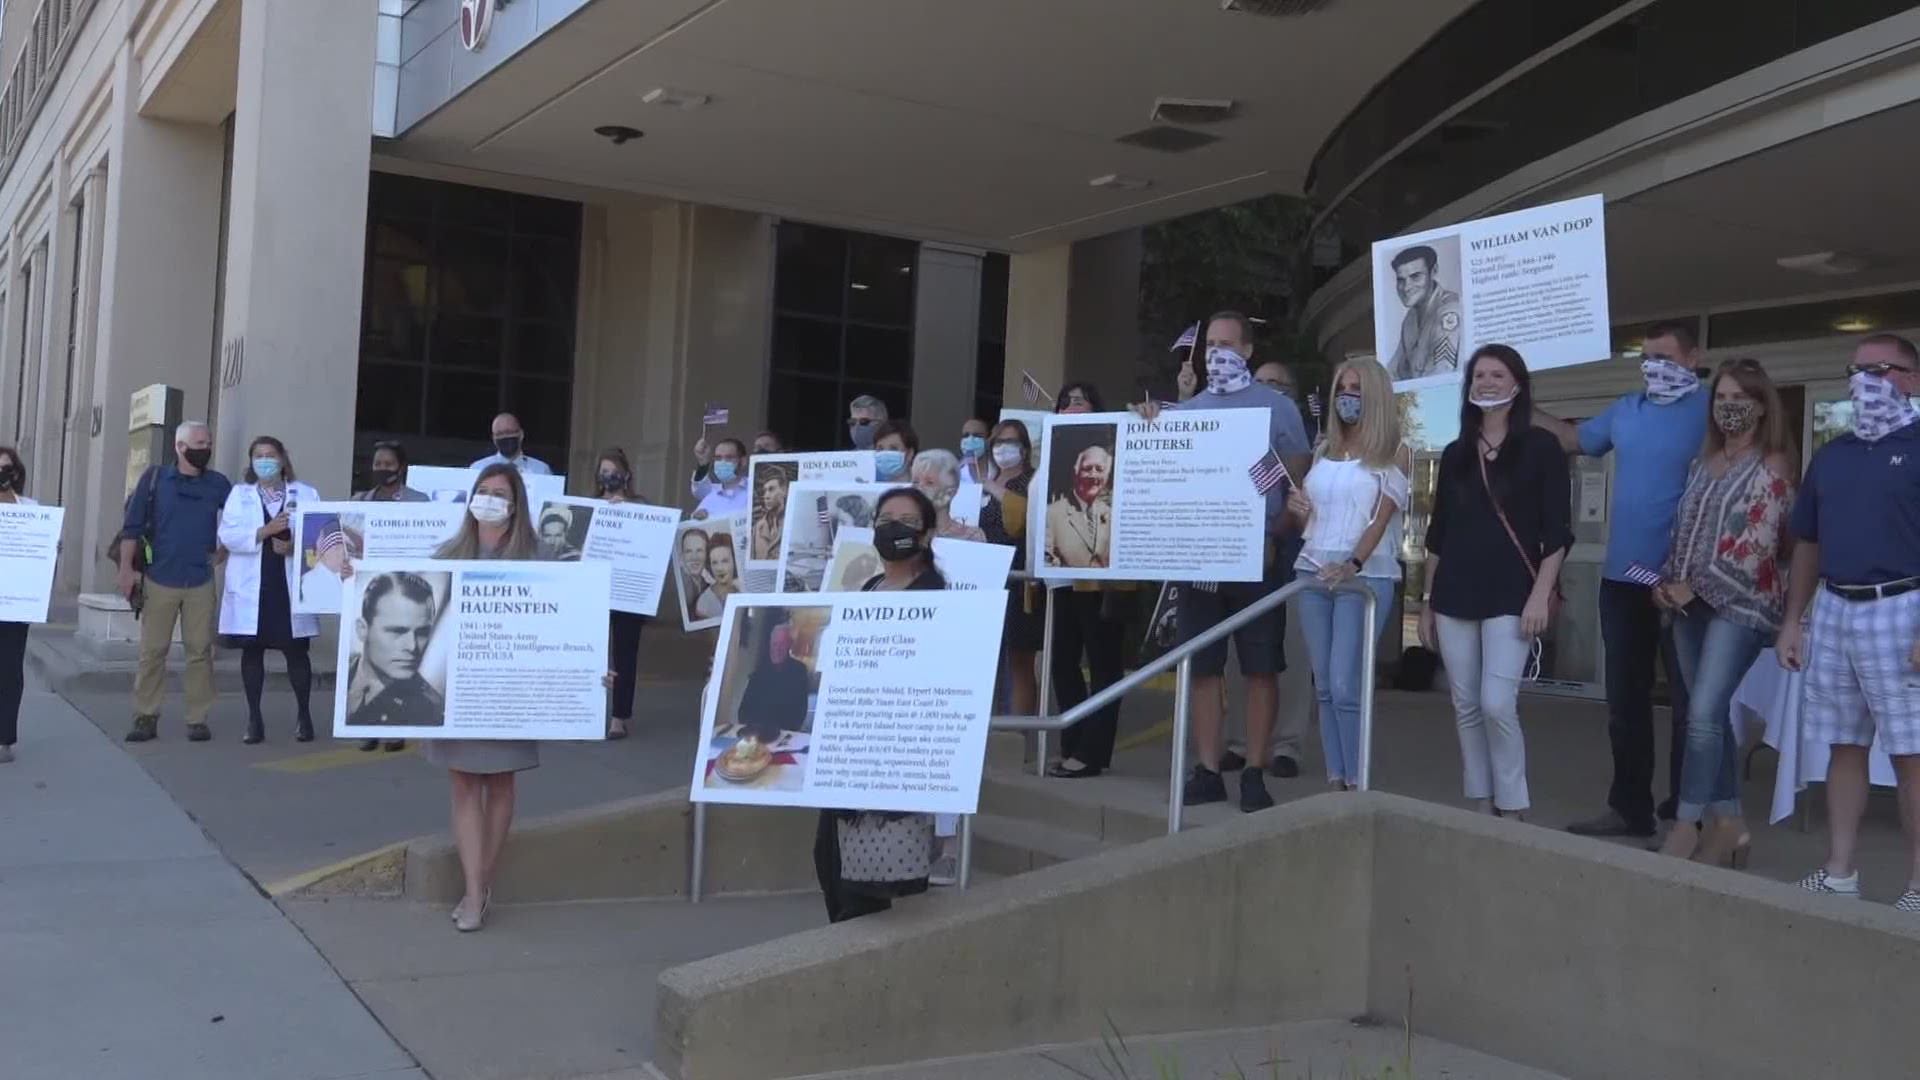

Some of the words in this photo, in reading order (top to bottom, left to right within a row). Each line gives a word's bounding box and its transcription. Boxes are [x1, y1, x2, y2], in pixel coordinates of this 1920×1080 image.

[1471, 231, 1528, 251] WILLIAM
[1532, 225, 1559, 239] VAN
[1563, 217, 1593, 233] DOP
[1471, 264, 1495, 275] Served
[1497, 261, 1515, 270] from
[1472, 273, 1499, 285] Highest
[1522, 264, 1553, 275] Sergeant
[1127, 423, 1160, 435] JOHN
[1164, 421, 1220, 432] GERARD
[1126, 439, 1193, 450] BOUTERSE
[803, 462, 823, 470] GENE
[832, 461, 858, 469] OLSON
[0, 511, 38, 520] ACKSON,
[598, 508, 632, 519] GEORGE
[634, 512, 672, 523] FRANCES
[370, 519, 410, 528] GEORGE
[413, 519, 448, 528] DEVON
[462, 585, 512, 597] RALPH
[517, 585, 532, 598] W.
[460, 602, 558, 614] HAUENSTEIN
[842, 607, 894, 621] DAVID
[898, 607, 938, 621] LOW
[459, 632, 486, 640] United
[515, 633, 538, 642] Army
[837, 635, 868, 644] Private
[869, 635, 889, 644] First
[892, 635, 916, 644] Class
[457, 642, 492, 651] Colonel,
[513, 643, 560, 653] Intelligence
[563, 643, 594, 652] Branch,
[457, 652, 473, 661] HQ
[836, 647, 850, 656] U.S.
[855, 647, 886, 657] Marine
[889, 647, 916, 659] Corps
[834, 659, 878, 669] 1945-1946
[829, 686, 847, 695] Good
[849, 686, 879, 695] Conduct
[907, 687, 931, 697] Expert
[827, 697, 856, 706] National
[876, 698, 895, 706] Team
[896, 698, 911, 706] East
[913, 698, 933, 707] Coast
[865, 711, 893, 720] pouring
[874, 722, 895, 730] Island
[915, 724, 934, 732] camp
[839, 733, 864, 742] ground
[898, 734, 917, 743] Japan
[907, 747, 929, 755] orders
[817, 755, 832, 764] hold
[834, 755, 848, 764] that
[816, 768, 834, 776] know
[836, 769, 850, 778] why
[848, 780, 869, 790] Camp
[901, 781, 926, 792] Special
